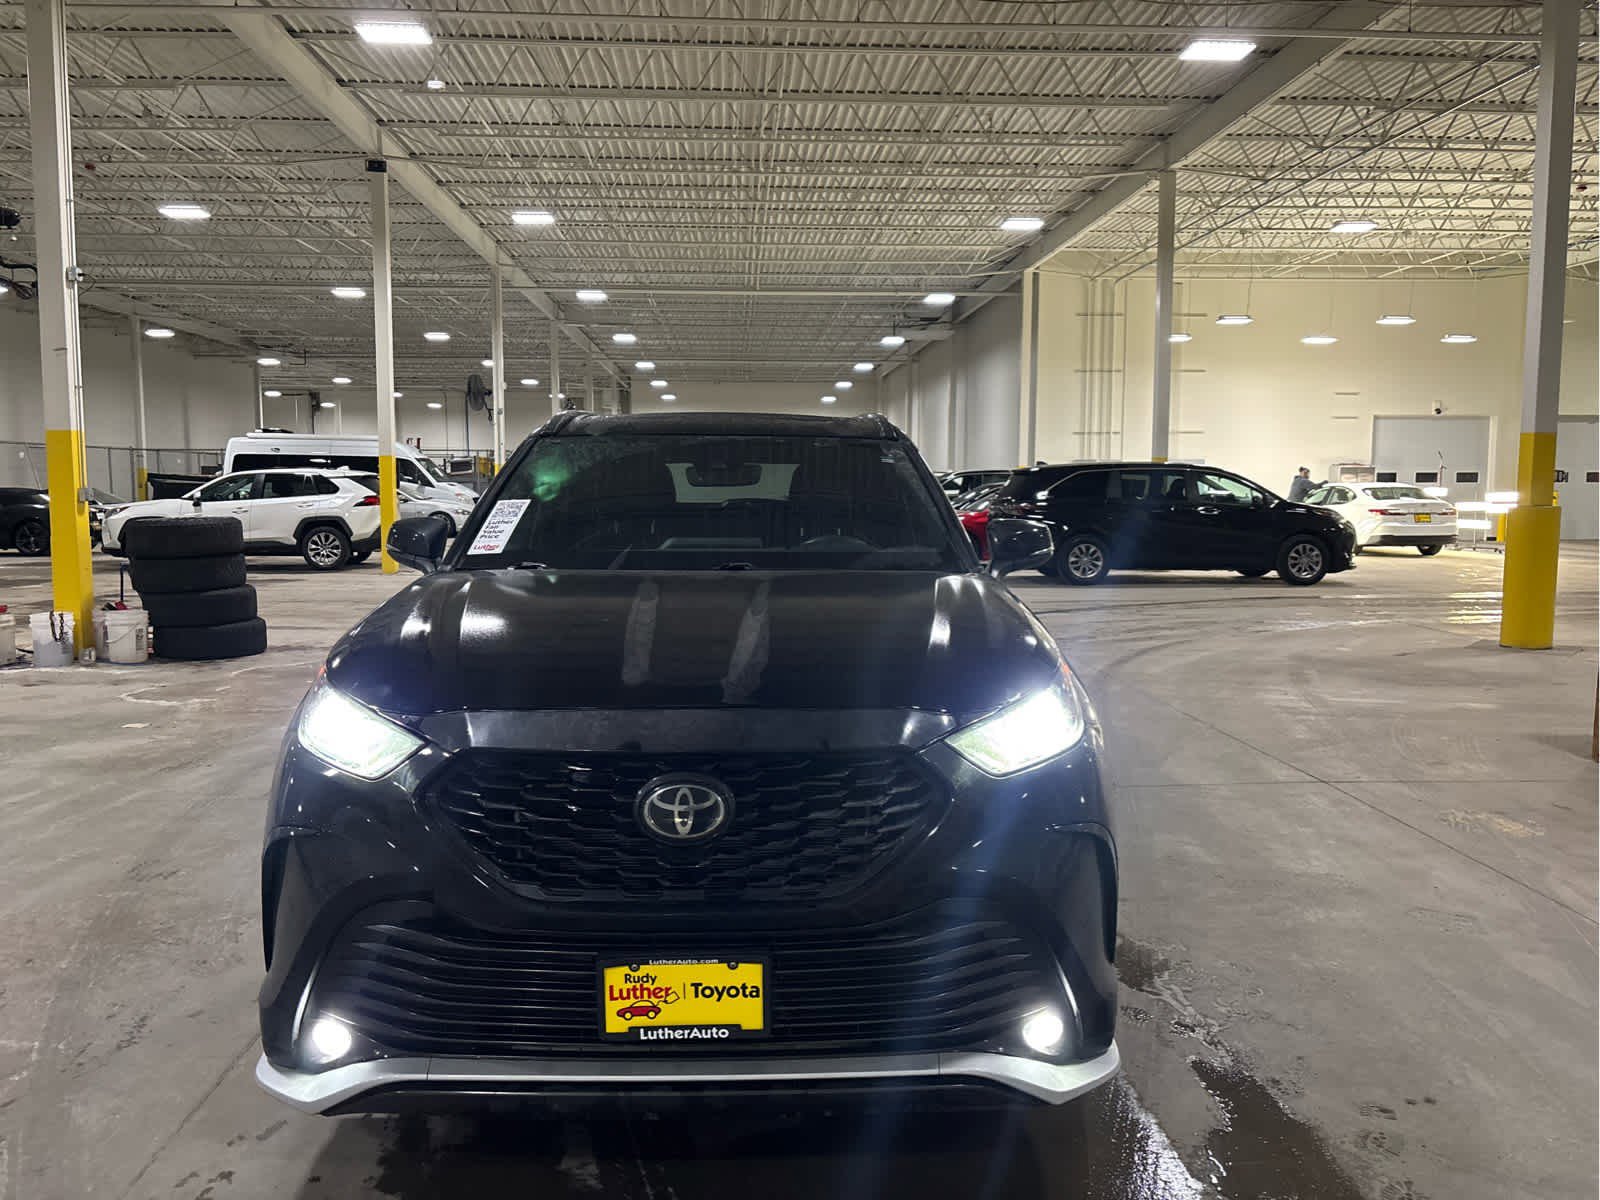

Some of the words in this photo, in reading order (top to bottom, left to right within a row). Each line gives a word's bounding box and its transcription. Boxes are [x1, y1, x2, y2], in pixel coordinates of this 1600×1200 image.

[649, 958, 719, 966] LutherAuto.com
[624, 973, 657, 985] Rudy
[609, 984, 672, 1001] Luther
[690, 983, 760, 1002] Toyota
[640, 1027, 729, 1040] LutherAuto
